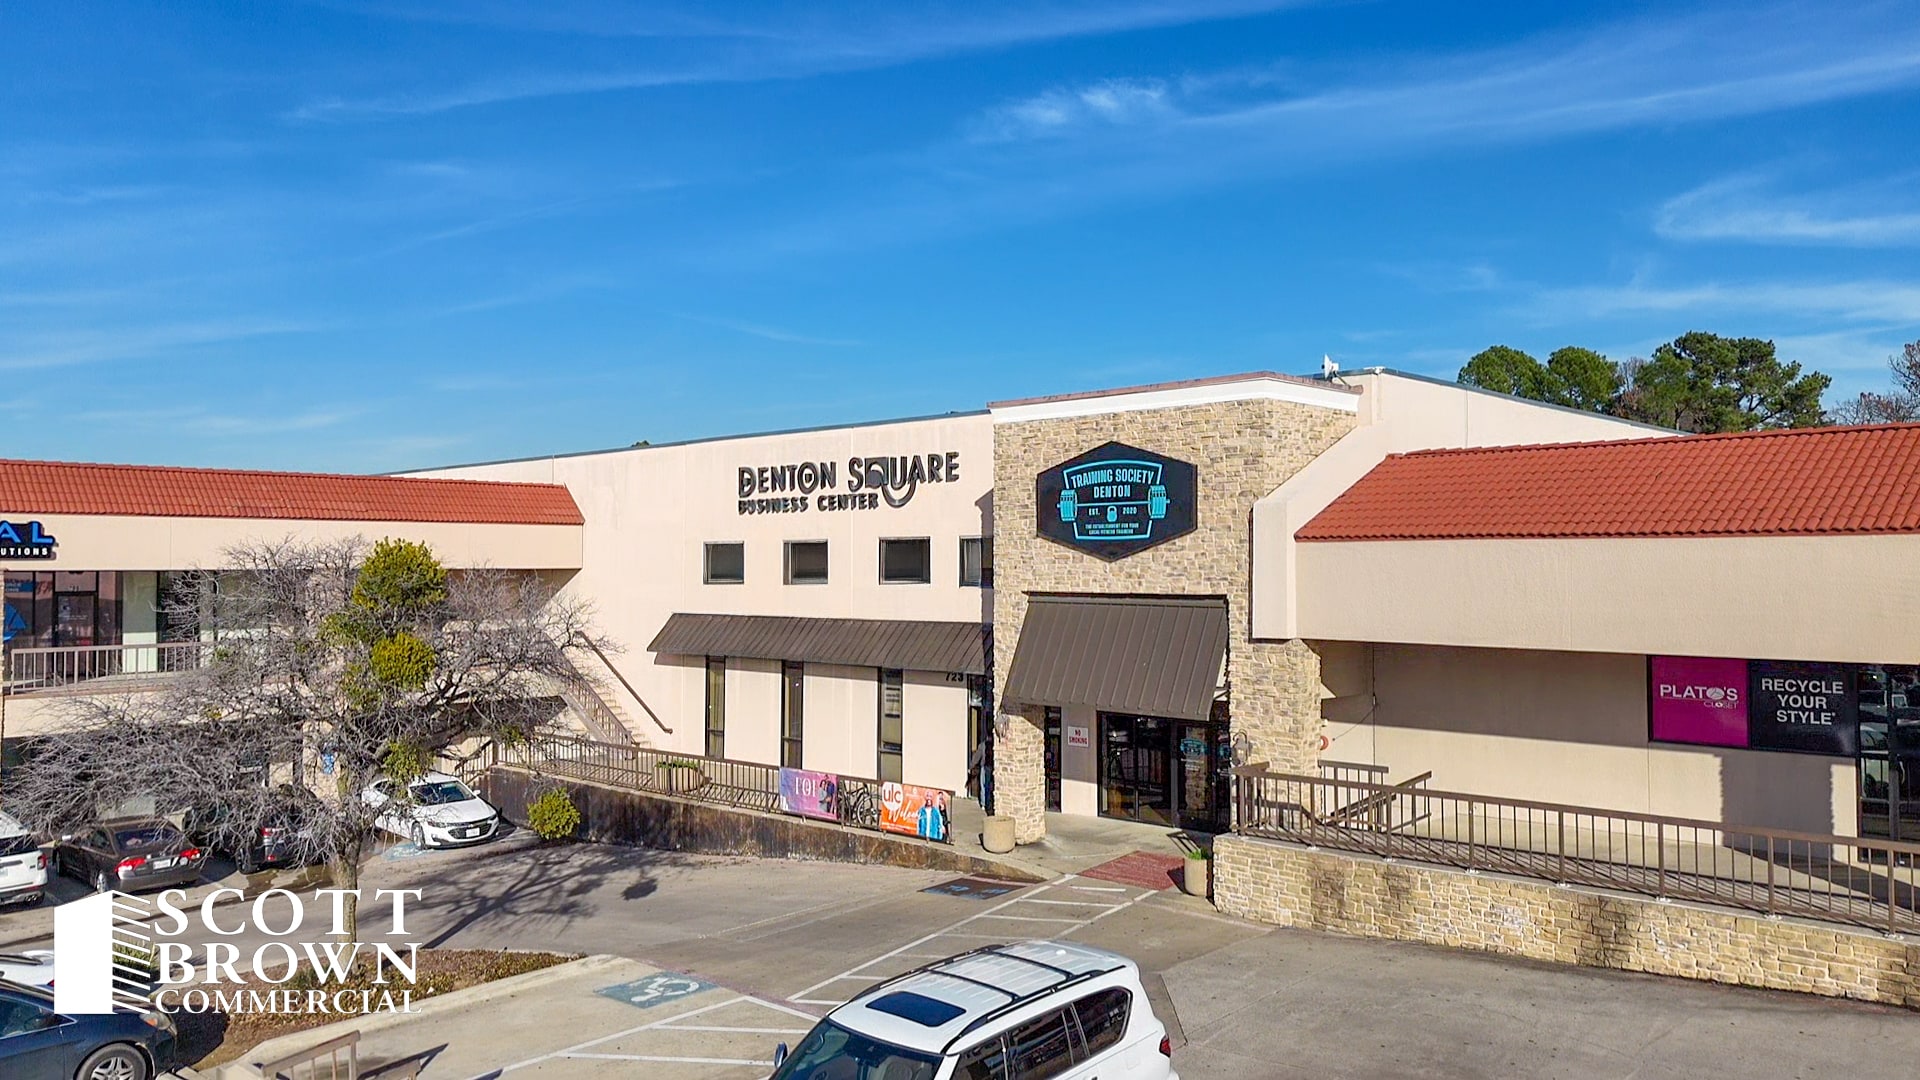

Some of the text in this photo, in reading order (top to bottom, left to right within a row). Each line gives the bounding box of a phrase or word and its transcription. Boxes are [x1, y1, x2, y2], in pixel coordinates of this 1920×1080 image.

[738, 452, 960, 508] DENTON SQUARE
[1070, 468, 1155, 489] TRAINING SOCIETY
[1093, 485, 1131, 499] DENTON
[738, 493, 879, 515] BUSINESS CENTER
[1088, 506, 1138, 516] EST. 2020
[945, 671, 964, 682] 723
[1660, 684, 1738, 701] PLATO'S
[1761, 678, 1844, 694] RECYCLE
[1703, 700, 1739, 710] CLOSET
[1777, 695, 1827, 709] YOUR
[1069, 736, 1087, 744] SMOKING
[883, 783, 902, 804] ulc
